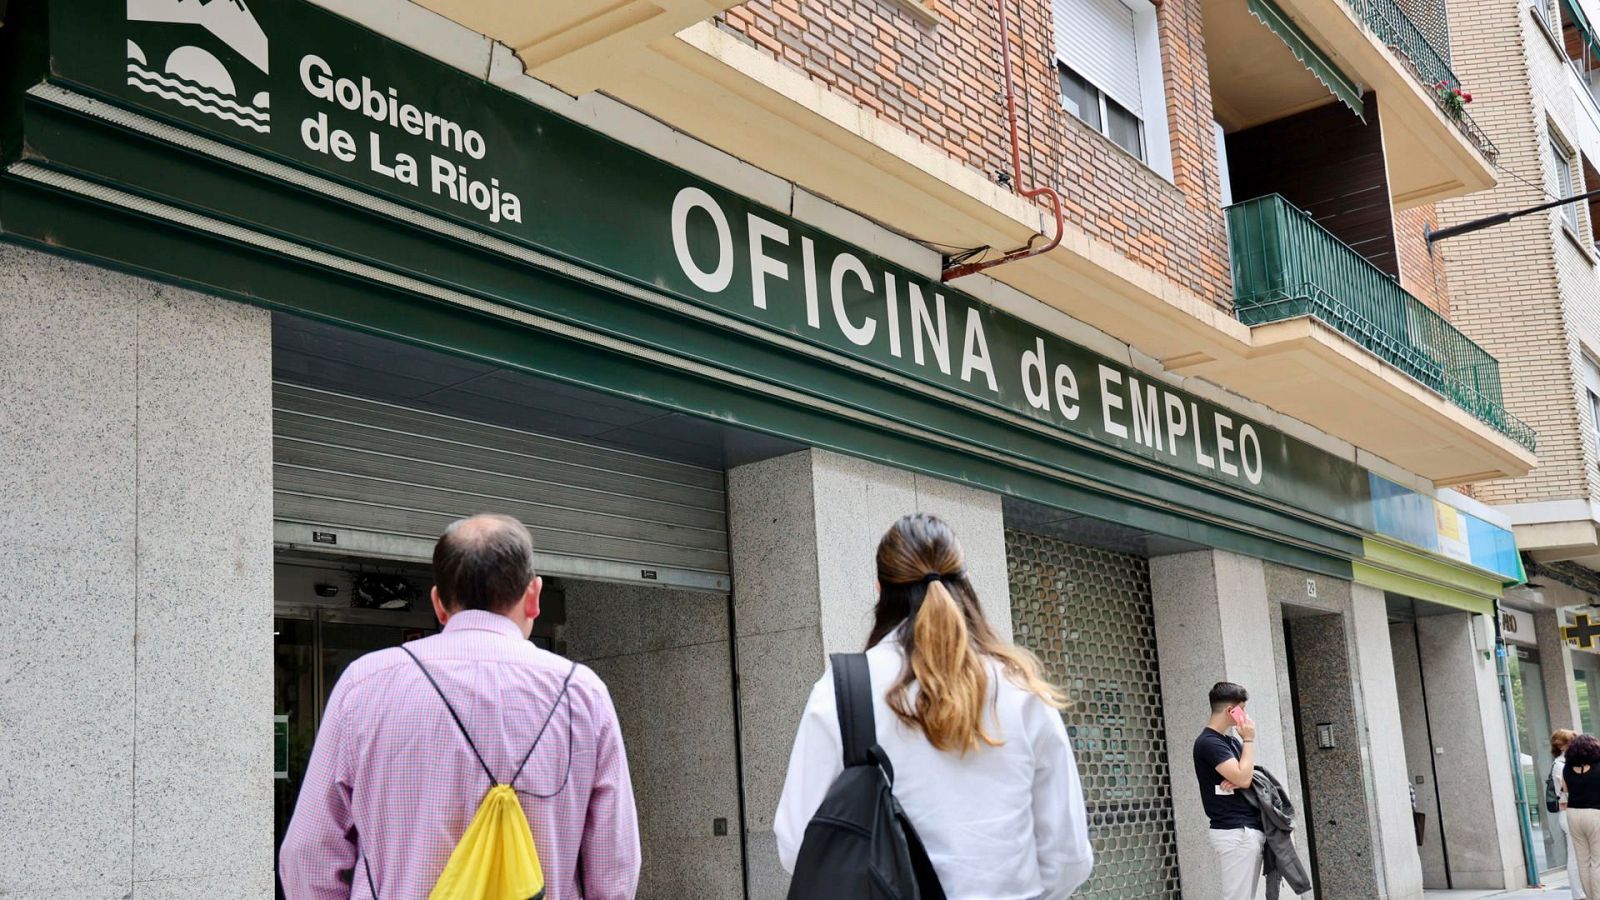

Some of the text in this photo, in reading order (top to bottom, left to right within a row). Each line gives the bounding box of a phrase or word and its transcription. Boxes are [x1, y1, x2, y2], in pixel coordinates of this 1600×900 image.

[300, 54, 486, 160] Gobierno
[301, 112, 522, 224] de La Rioja
[671, 187, 1263, 486] OFICINA de EMPLEO
